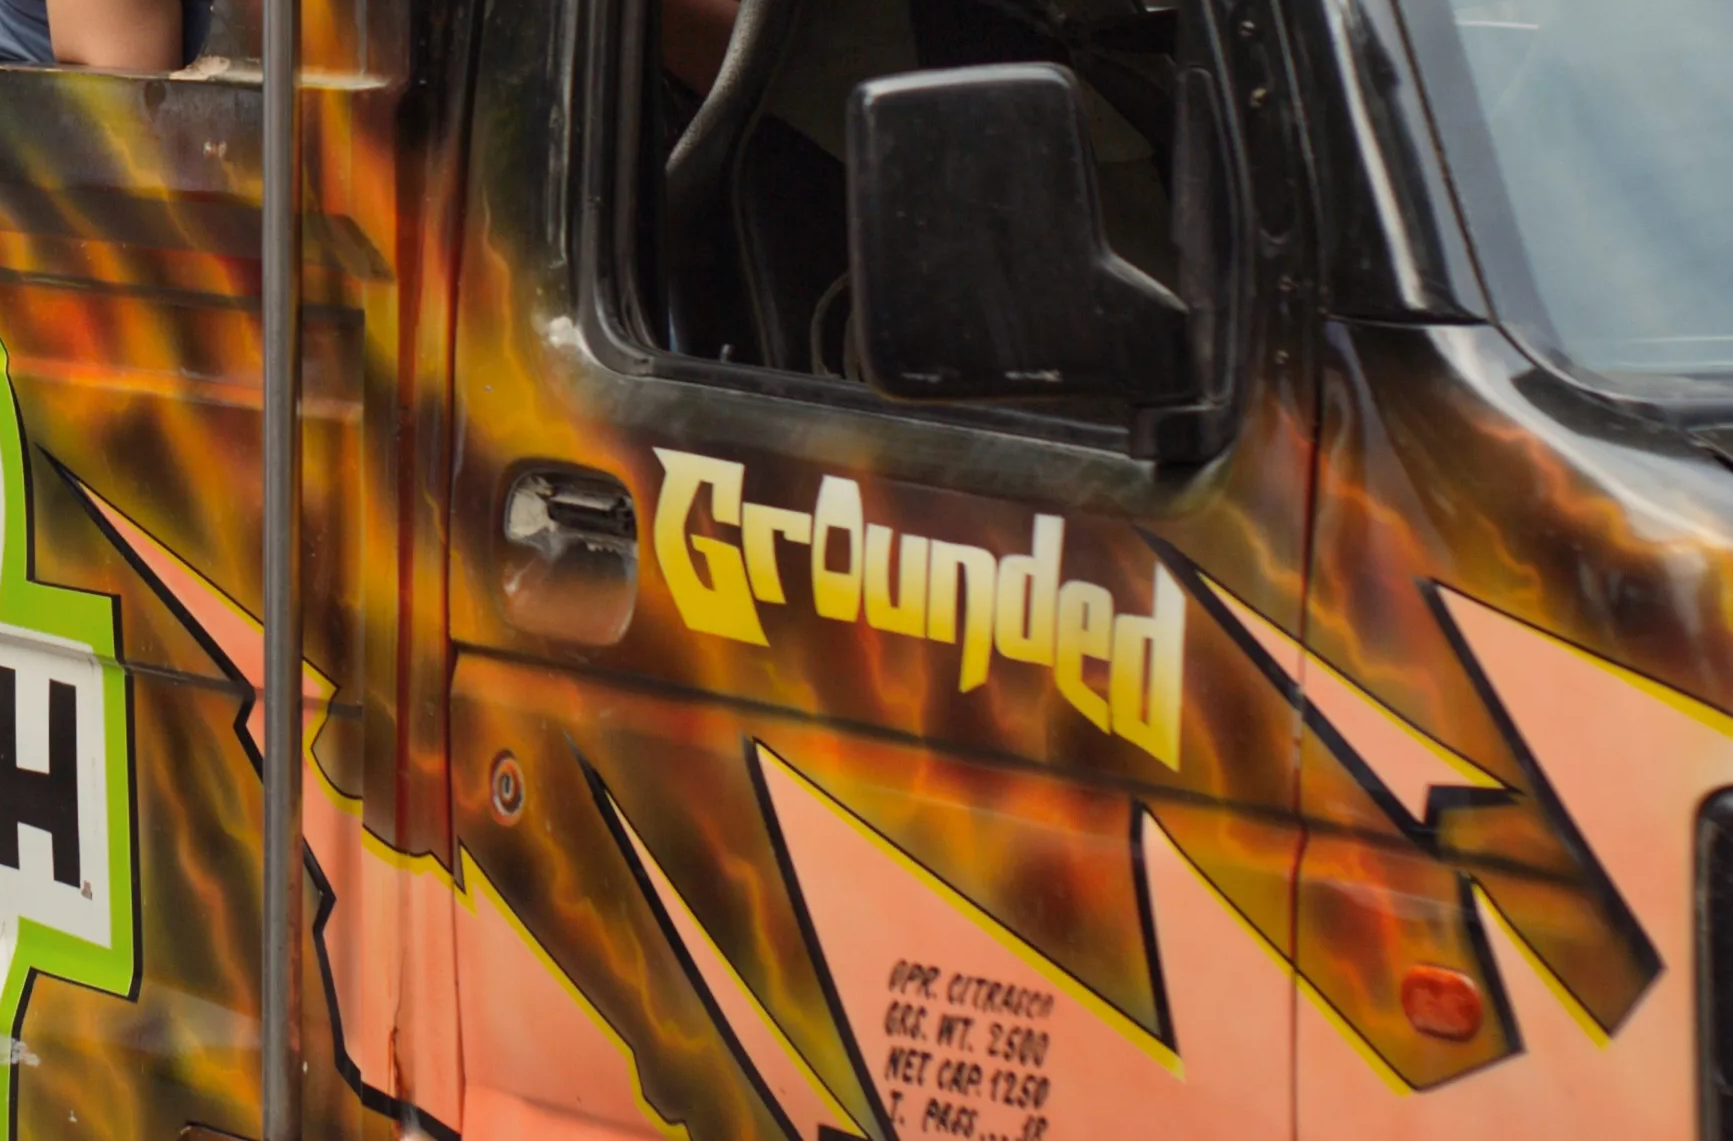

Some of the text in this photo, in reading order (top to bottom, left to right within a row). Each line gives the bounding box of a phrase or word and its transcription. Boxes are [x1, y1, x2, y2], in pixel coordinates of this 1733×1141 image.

[652, 446, 1186, 773] Grounded
[885, 1046, 931, 1086] NET
[991, 1069, 1050, 1110] 1250
